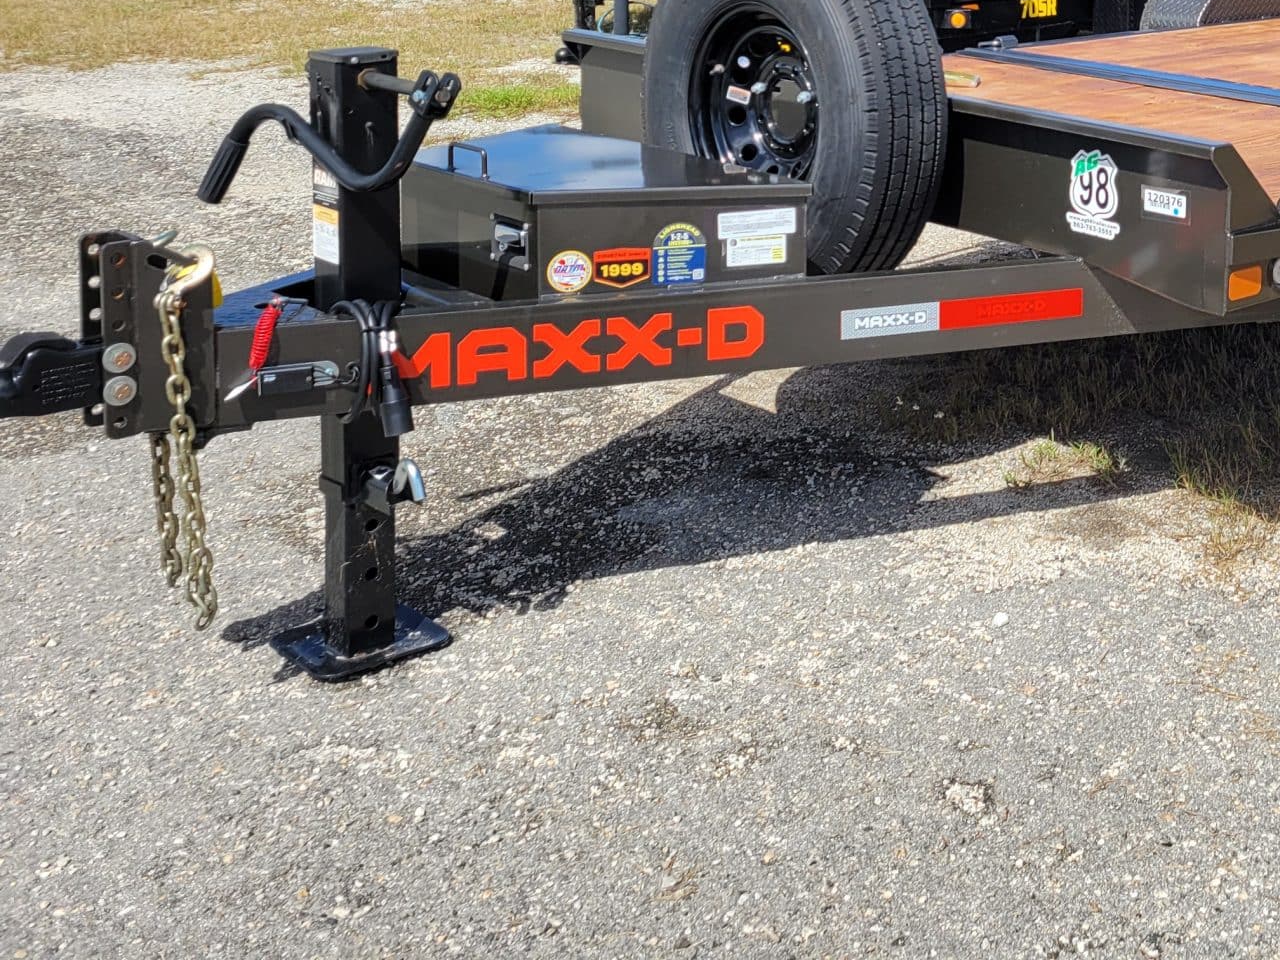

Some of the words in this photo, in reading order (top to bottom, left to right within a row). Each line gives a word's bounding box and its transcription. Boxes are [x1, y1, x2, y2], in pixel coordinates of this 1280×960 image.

[1075, 152, 1100, 176] AG
[1080, 167, 1109, 209] 98
[1148, 191, 1183, 207] 120376
[600, 262, 644, 278] 1999
[854, 311, 928, 330] MAXX-D
[391, 305, 765, 388] MAXX-D
